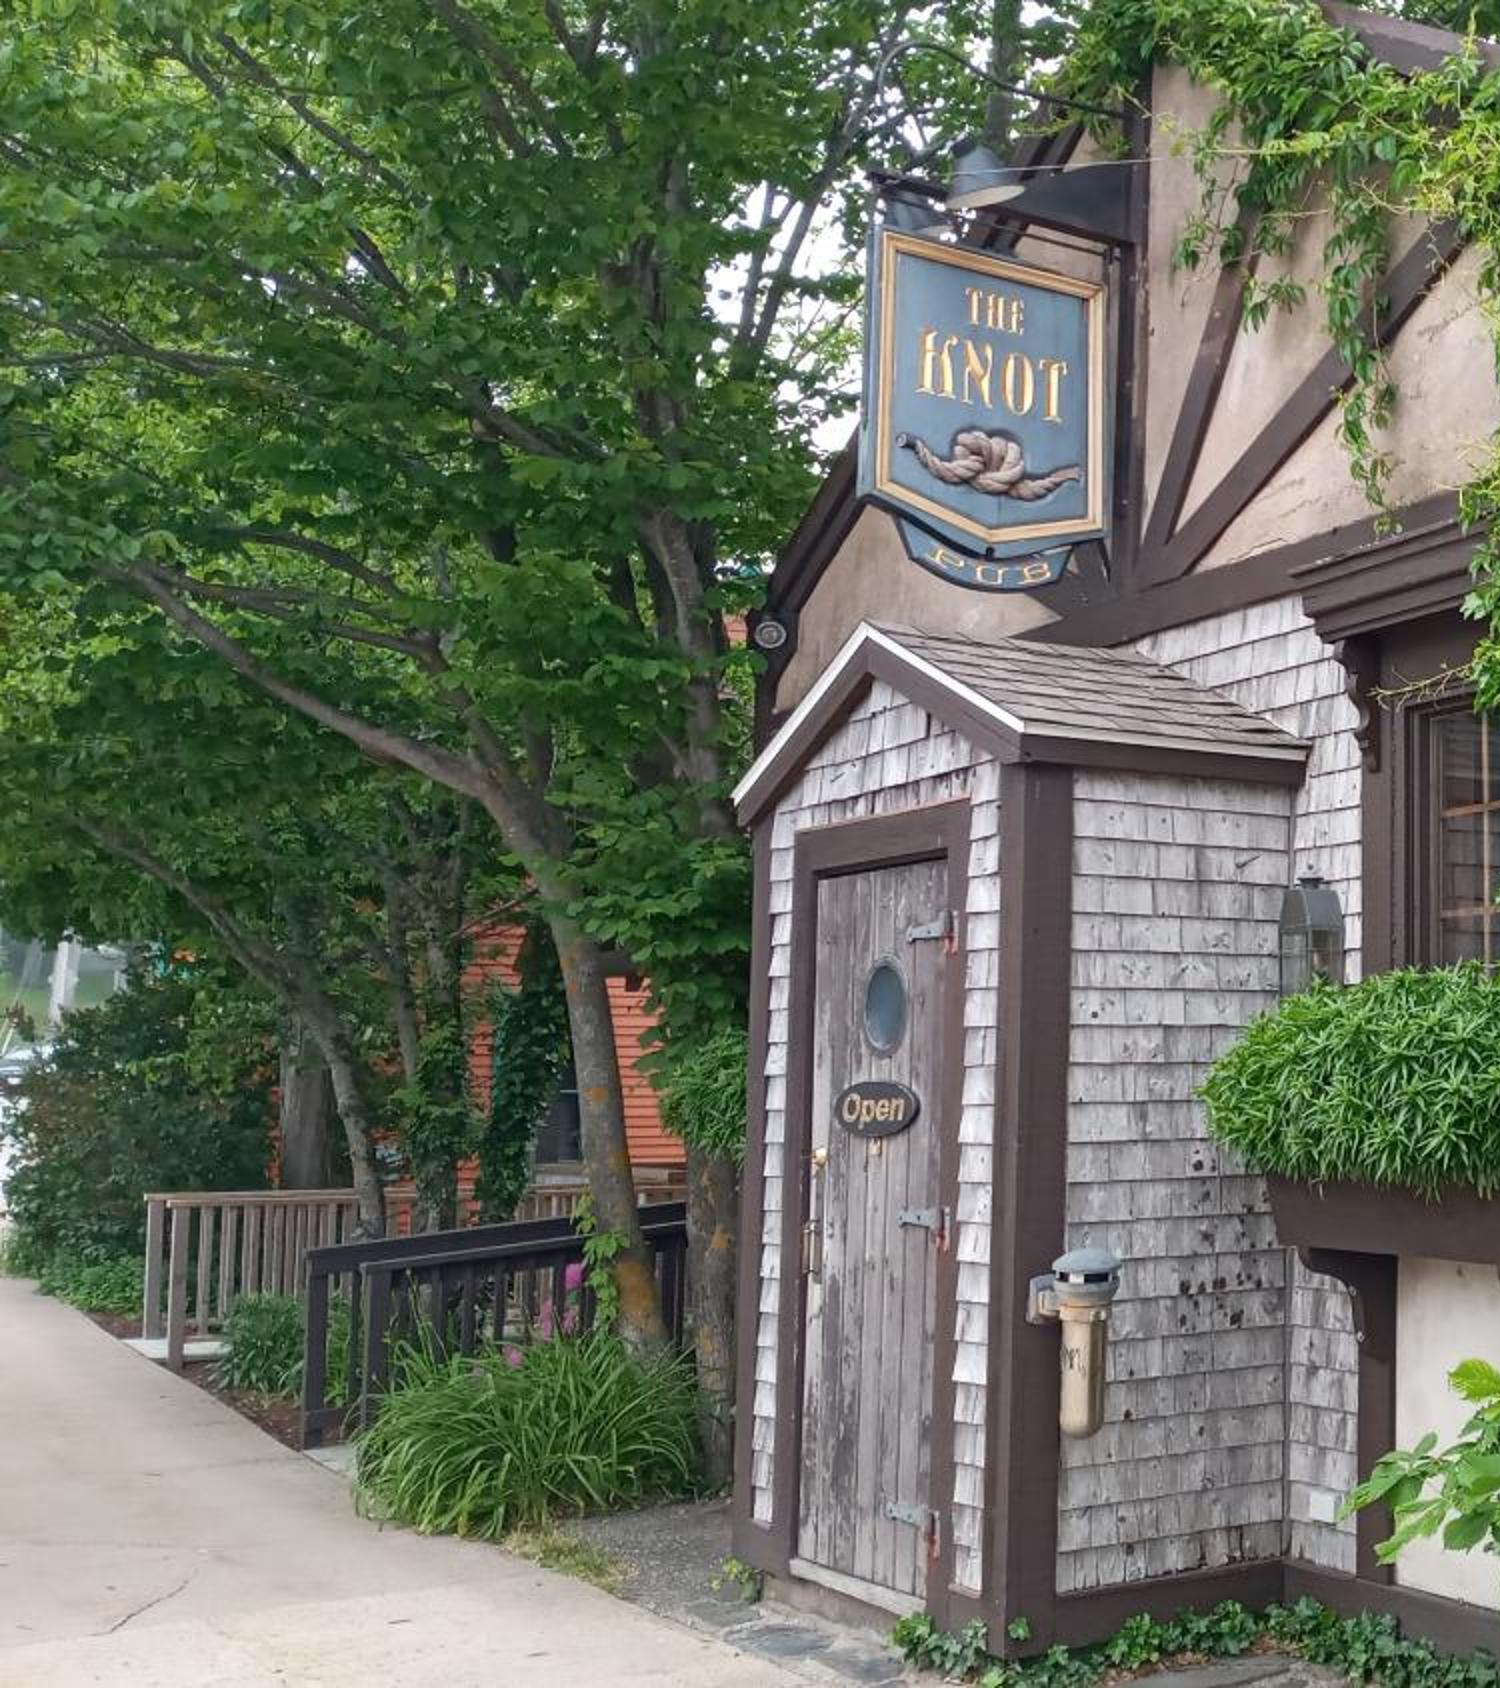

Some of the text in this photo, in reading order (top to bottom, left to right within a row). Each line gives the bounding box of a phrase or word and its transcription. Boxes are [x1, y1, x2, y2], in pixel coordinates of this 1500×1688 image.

[965, 287, 1025, 336] THE
[915, 327, 1068, 423] KNOT
[930, 546, 1051, 586] PUB
[842, 1093, 905, 1130] Open
